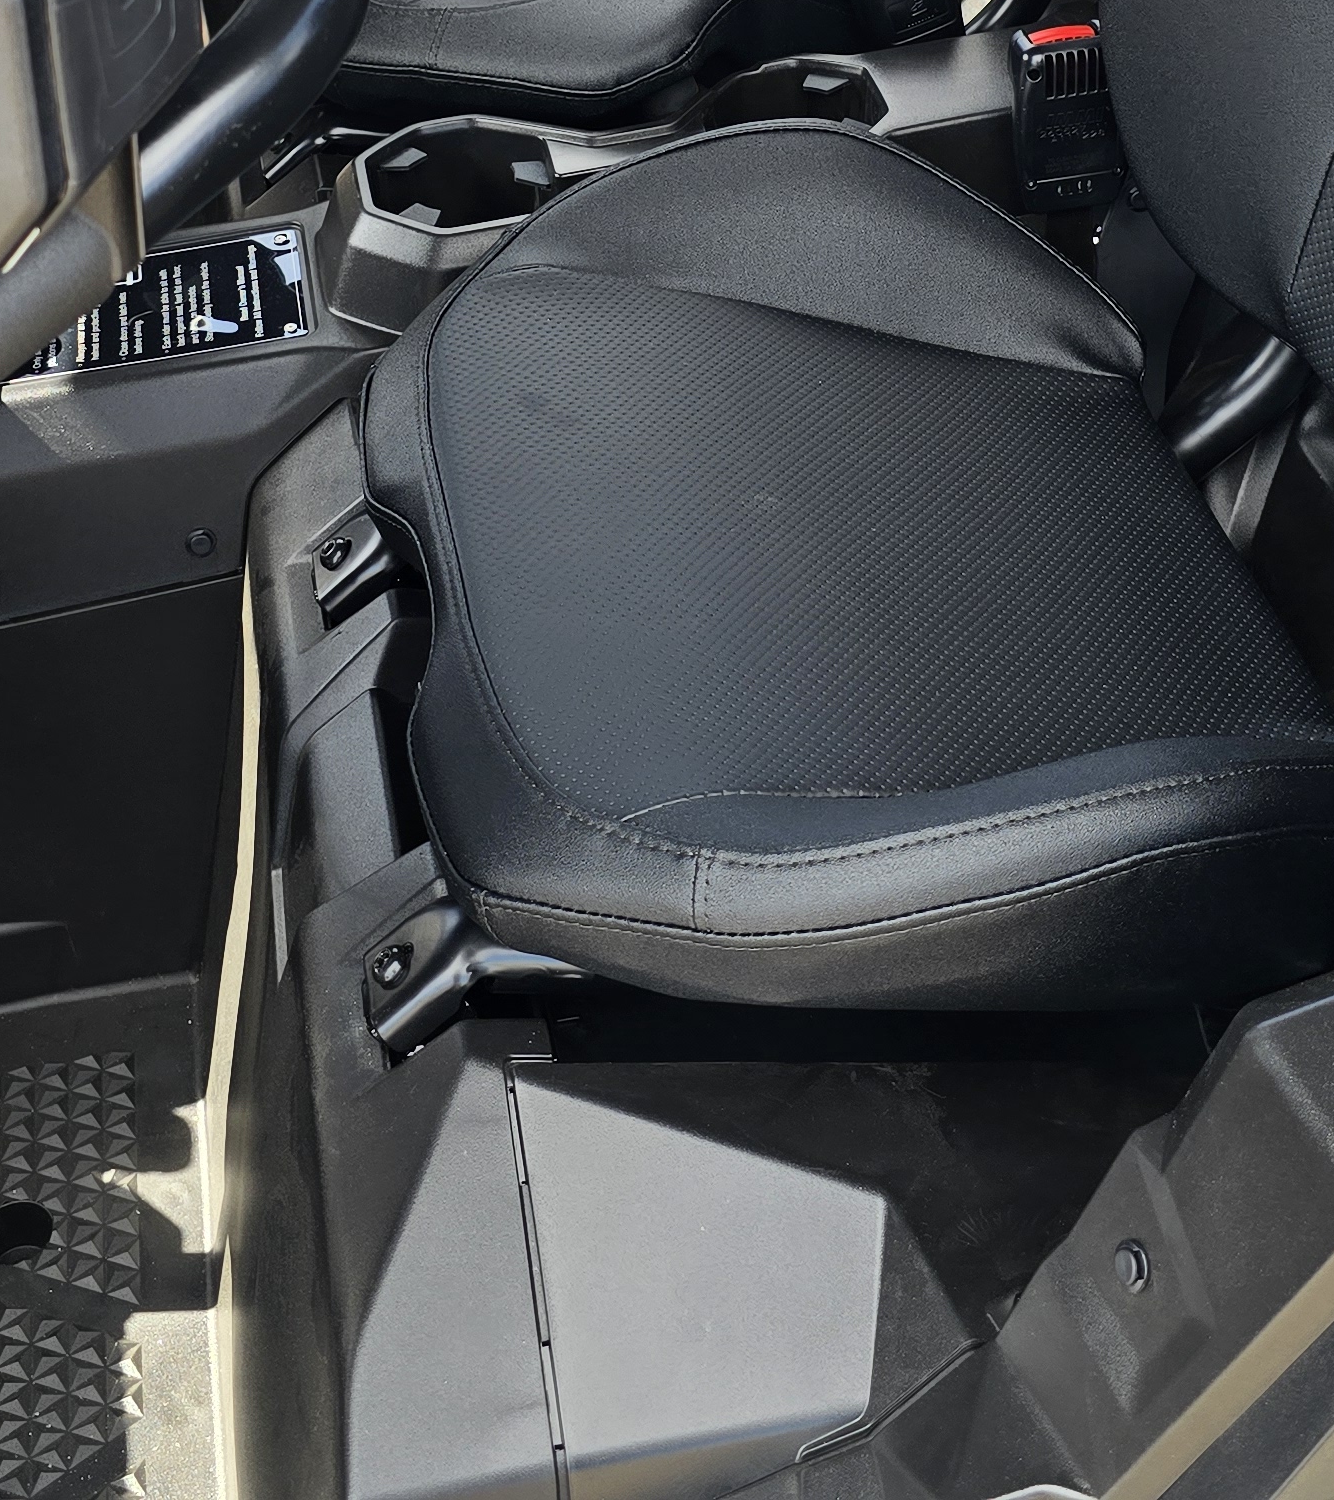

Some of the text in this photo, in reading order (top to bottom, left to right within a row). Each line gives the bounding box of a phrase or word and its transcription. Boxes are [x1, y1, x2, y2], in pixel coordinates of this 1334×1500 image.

[249, 270, 258, 280] and
[201, 281, 210, 289] the
[235, 266, 248, 321] Read Owner's Manual
[119, 316, 128, 326] and
[255, 320, 264, 338] Follow
[91, 333, 99, 342] and
[162, 335, 171, 349] Each
[190, 334, 199, 344] and
[32, 357, 43, 368] Only
